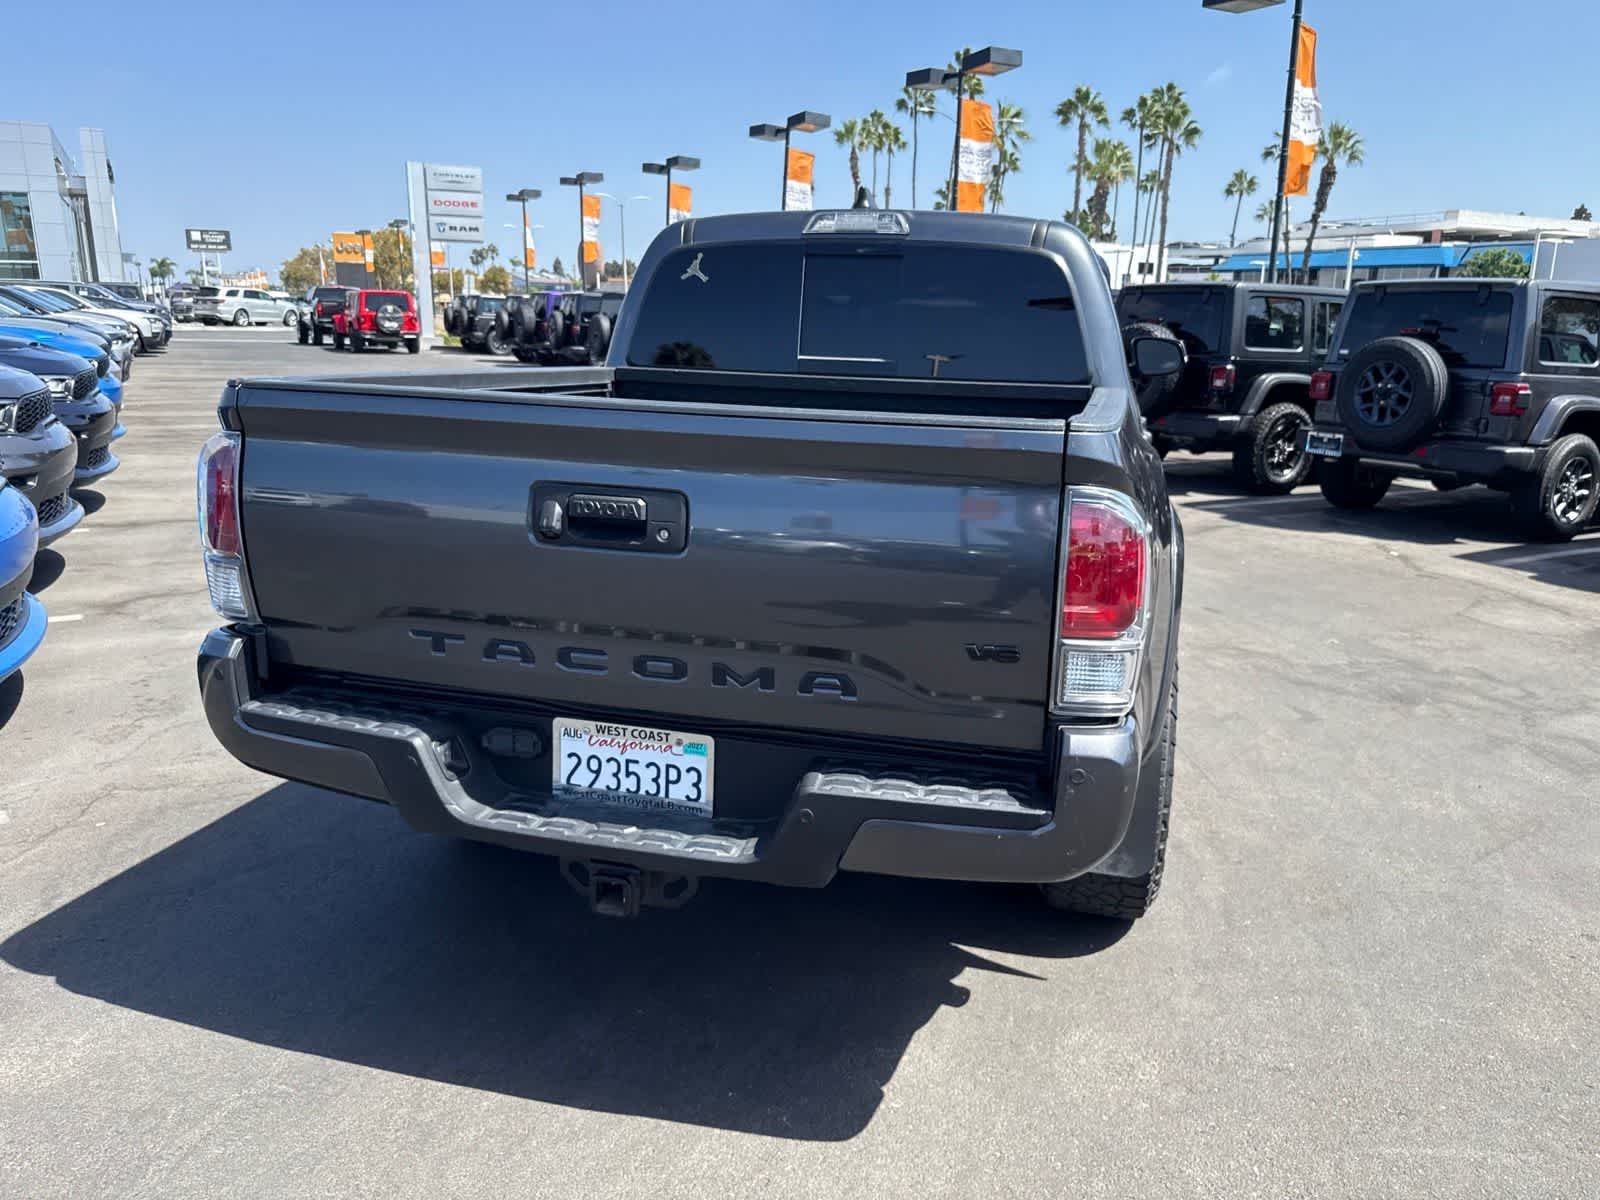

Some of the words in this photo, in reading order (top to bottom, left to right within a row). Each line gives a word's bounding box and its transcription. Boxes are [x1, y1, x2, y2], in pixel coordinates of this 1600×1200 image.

[433, 199, 479, 208] DODGE
[448, 225, 480, 233] RAM
[574, 499, 640, 521] TOYOTA
[964, 643, 1021, 664] V6
[408, 628, 858, 701] TACOMA
[563, 727, 583, 739] AUG
[595, 724, 628, 738] WEST
[630, 728, 671, 742] COAST
[588, 734, 684, 756] California
[566, 752, 702, 803] 29353P3
